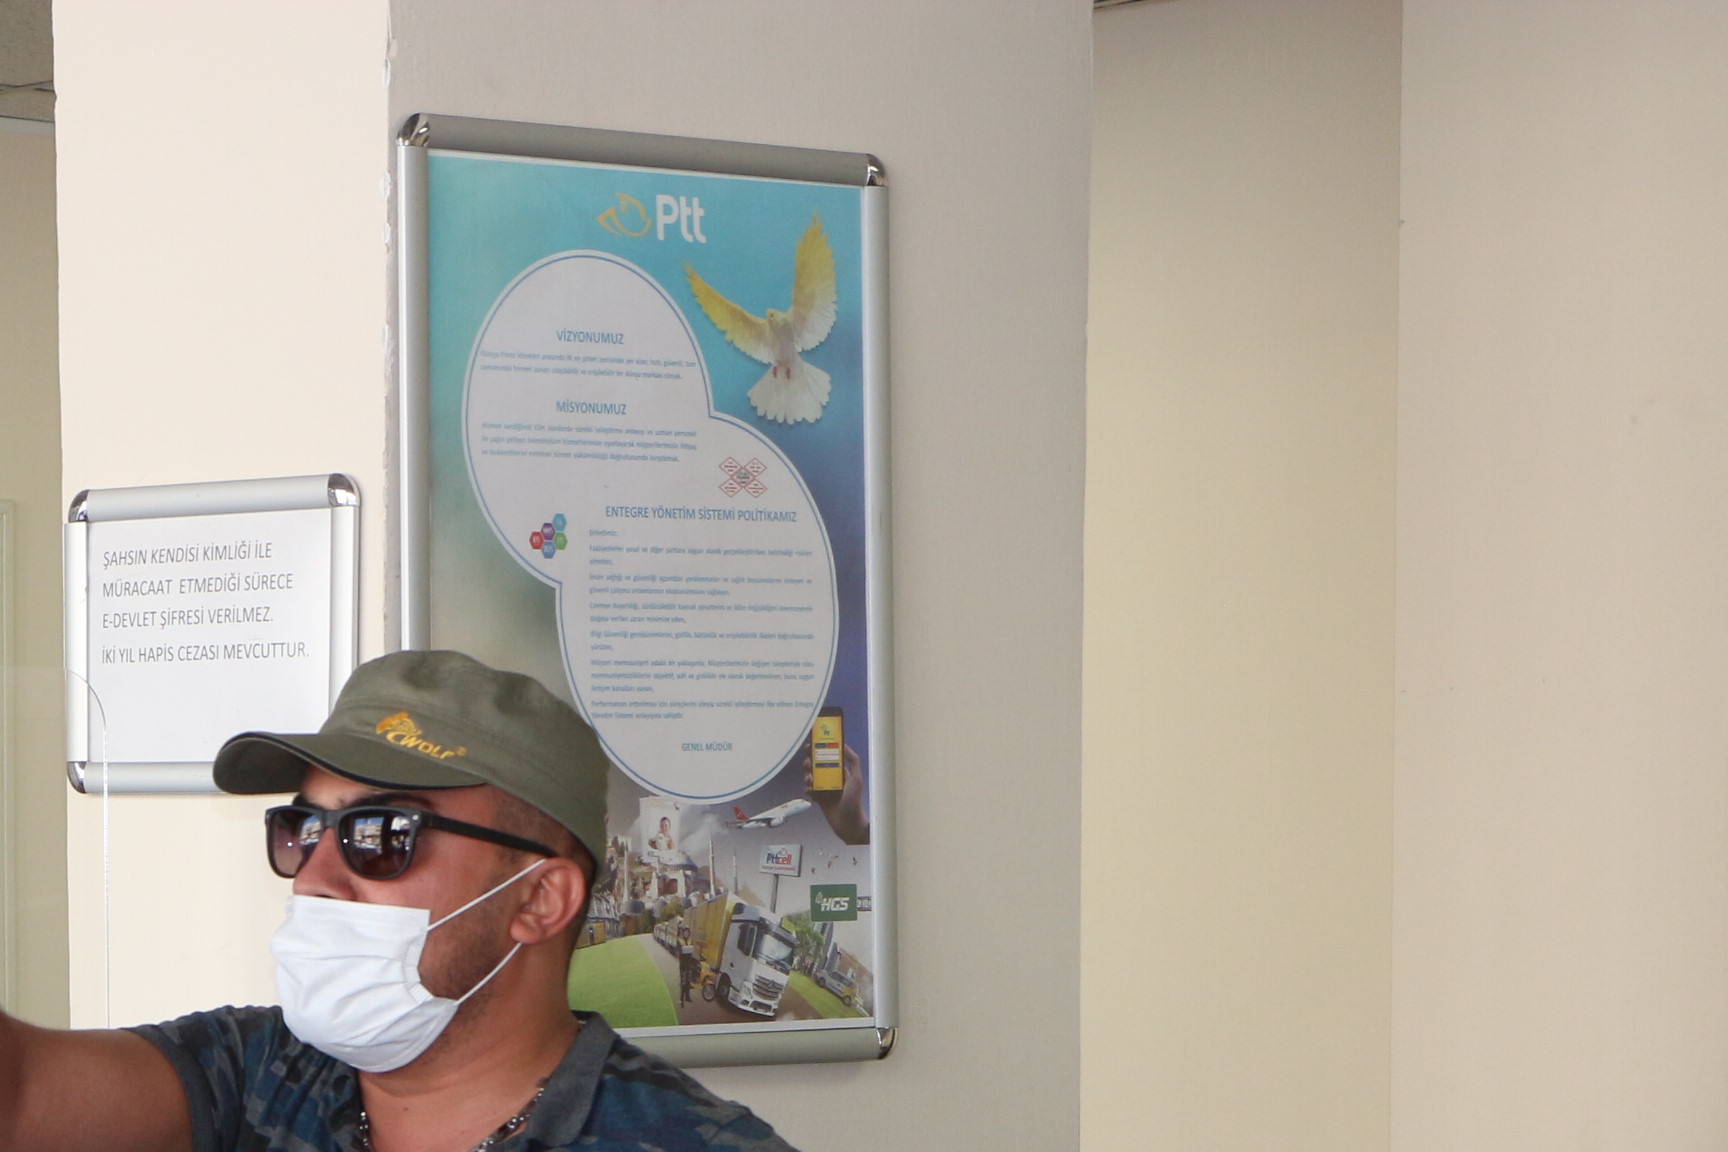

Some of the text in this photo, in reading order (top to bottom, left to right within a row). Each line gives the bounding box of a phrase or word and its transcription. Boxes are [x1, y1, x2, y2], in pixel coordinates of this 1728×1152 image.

[656, 194, 706, 243] Ptt
[557, 328, 624, 344] VİZYONUMUZ
[556, 399, 626, 415] MİSYONUMUZ
[606, 505, 796, 522] ENTEGRE YÖNETİM SİSTEMİ POLİTİKAMIZ
[103, 541, 272, 570] ŞAHSIN KENDİSİ KİMLİĞİ İLE
[103, 572, 293, 597] MÜRACAAT ETMEDİĞİ SÜRECE
[103, 604, 273, 630] E-DEVLET ŞİFRESİ VERİLMEZ.
[102, 641, 309, 664] İKİ YIL HAPİS CEZASI MEVCUTTUR.
[682, 741, 733, 752] GENEL MÜDÜR
[821, 897, 850, 912] HGS
